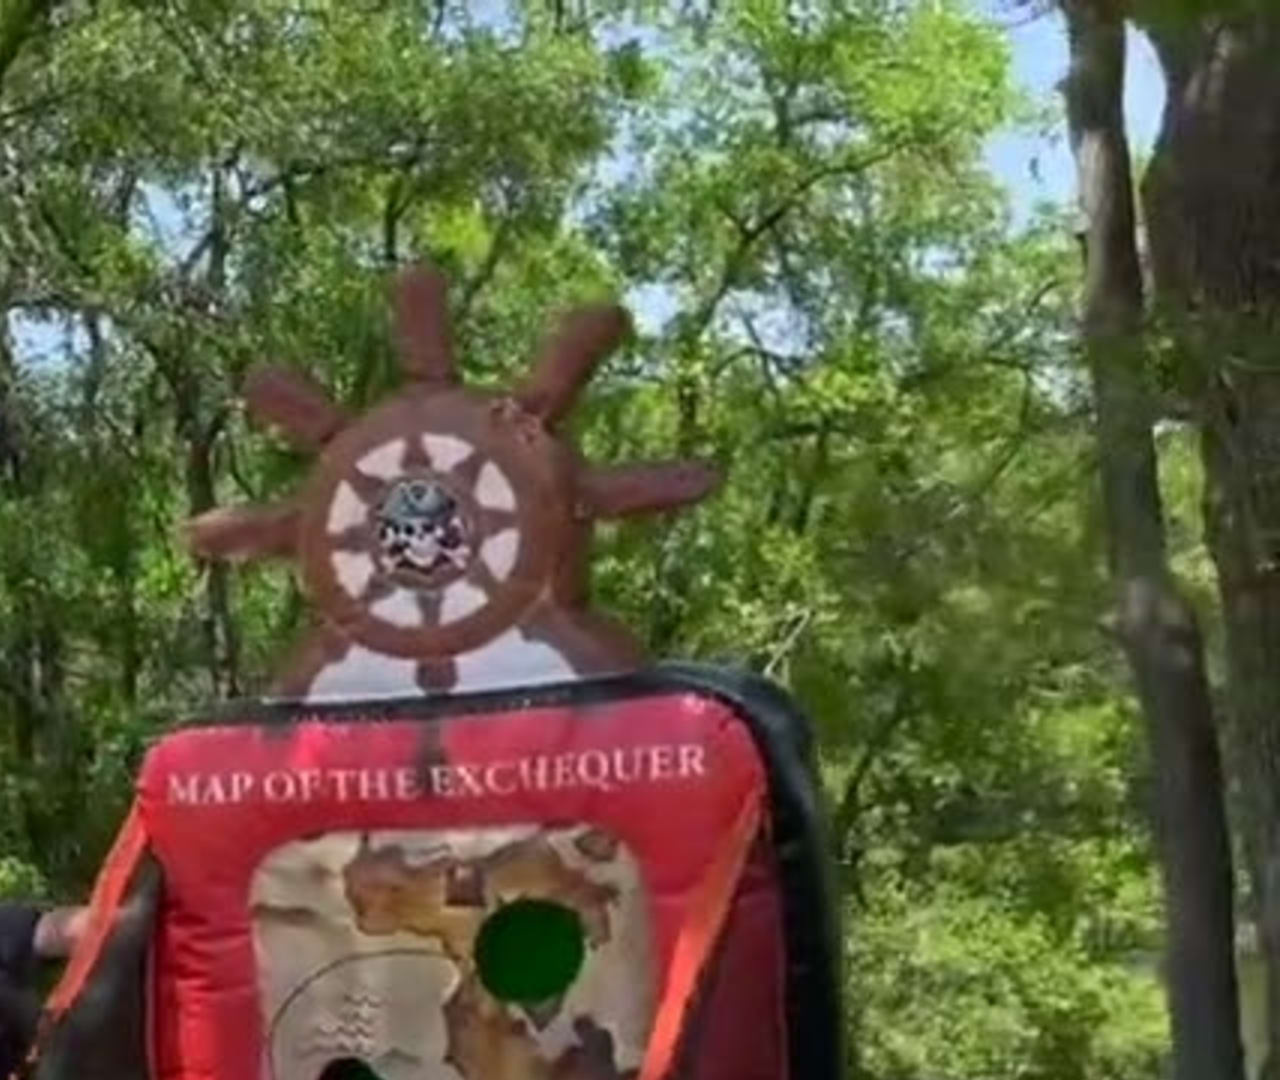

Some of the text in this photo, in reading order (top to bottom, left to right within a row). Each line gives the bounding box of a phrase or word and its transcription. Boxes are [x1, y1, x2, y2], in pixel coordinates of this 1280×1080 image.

[167, 743, 706, 805] MAP OF THE EXCHEQUER
